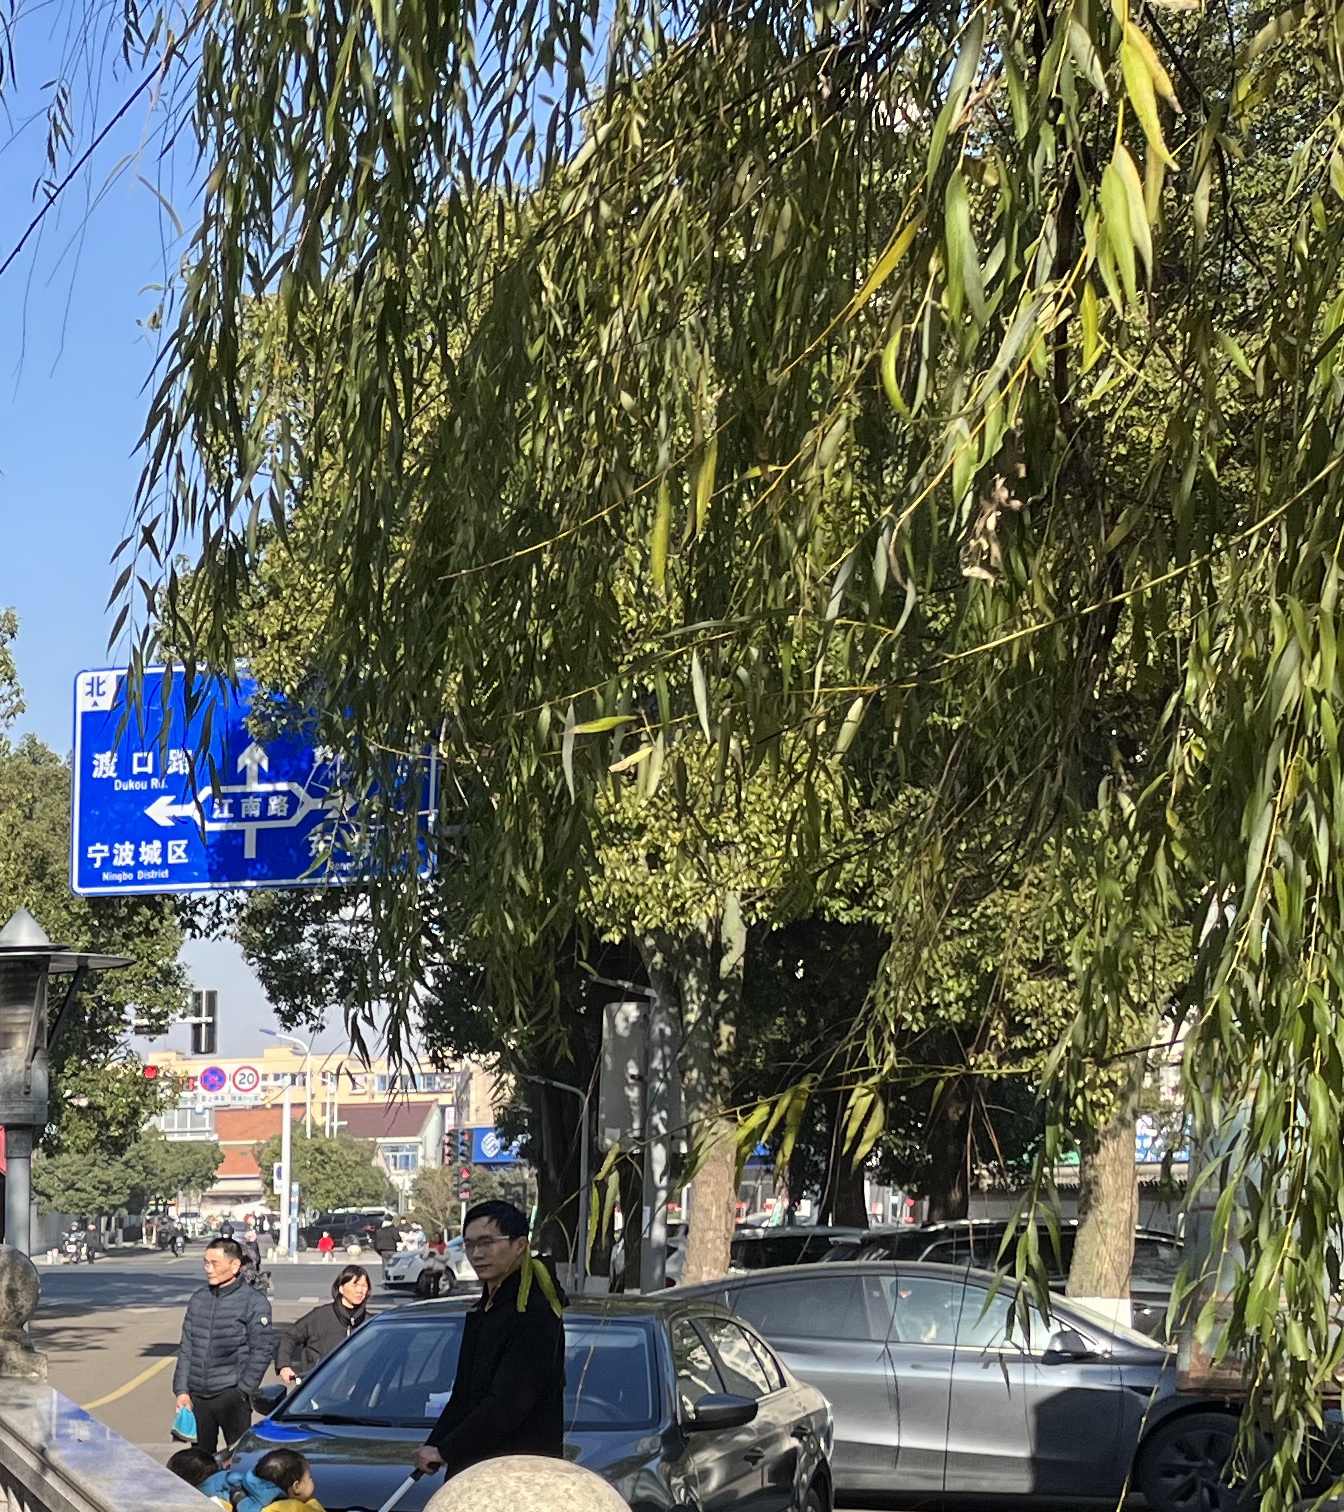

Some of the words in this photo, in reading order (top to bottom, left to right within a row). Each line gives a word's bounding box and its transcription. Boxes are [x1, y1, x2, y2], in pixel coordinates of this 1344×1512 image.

[85, 676, 106, 697] 北
[92, 749, 192, 778] 渡口路
[114, 779, 148, 791] Dukou
[213, 795, 289, 819] 江南路
[87, 839, 189, 868] 宁波城区
[102, 871, 134, 883] Ningbo
[137, 869, 169, 881] District
[238, 1073, 255, 1085] 20
